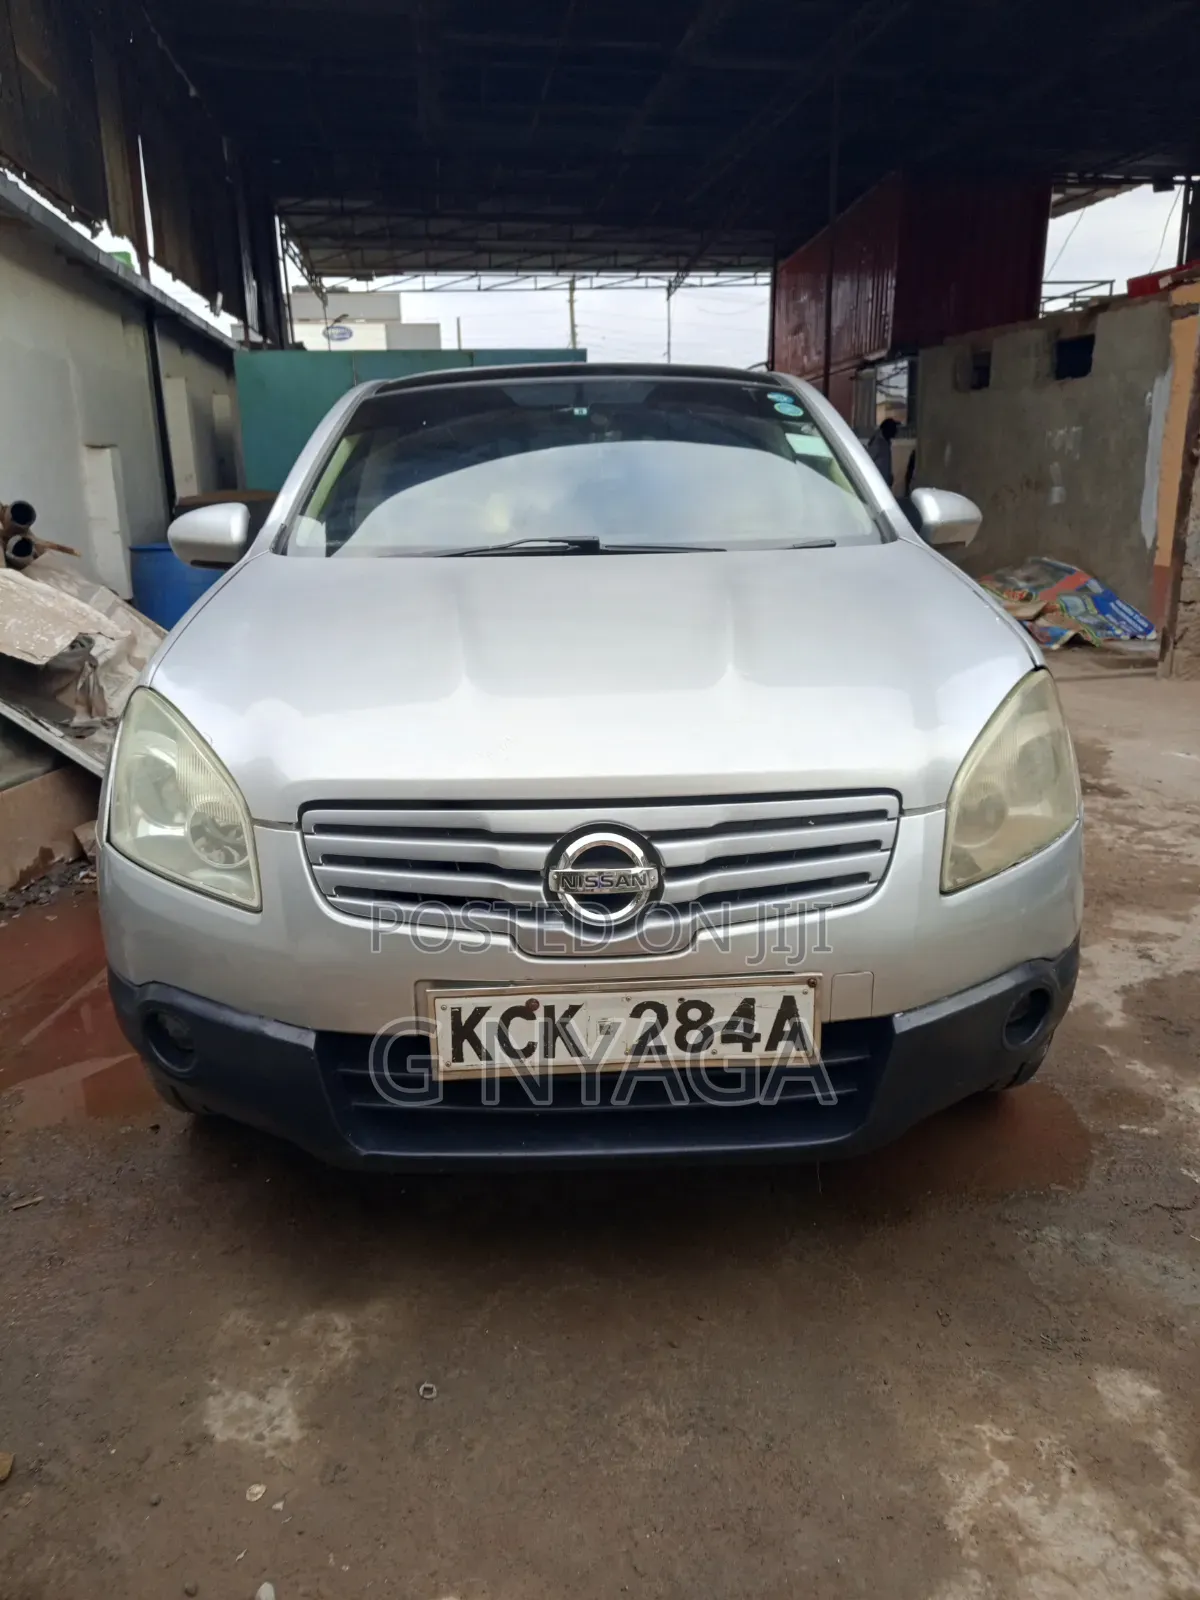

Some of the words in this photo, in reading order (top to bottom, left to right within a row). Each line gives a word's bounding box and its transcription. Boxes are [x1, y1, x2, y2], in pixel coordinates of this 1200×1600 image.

[561, 874, 648, 889] NISSAN
[450, 1001, 588, 1063] KCK
[629, 994, 808, 1056] 284A
